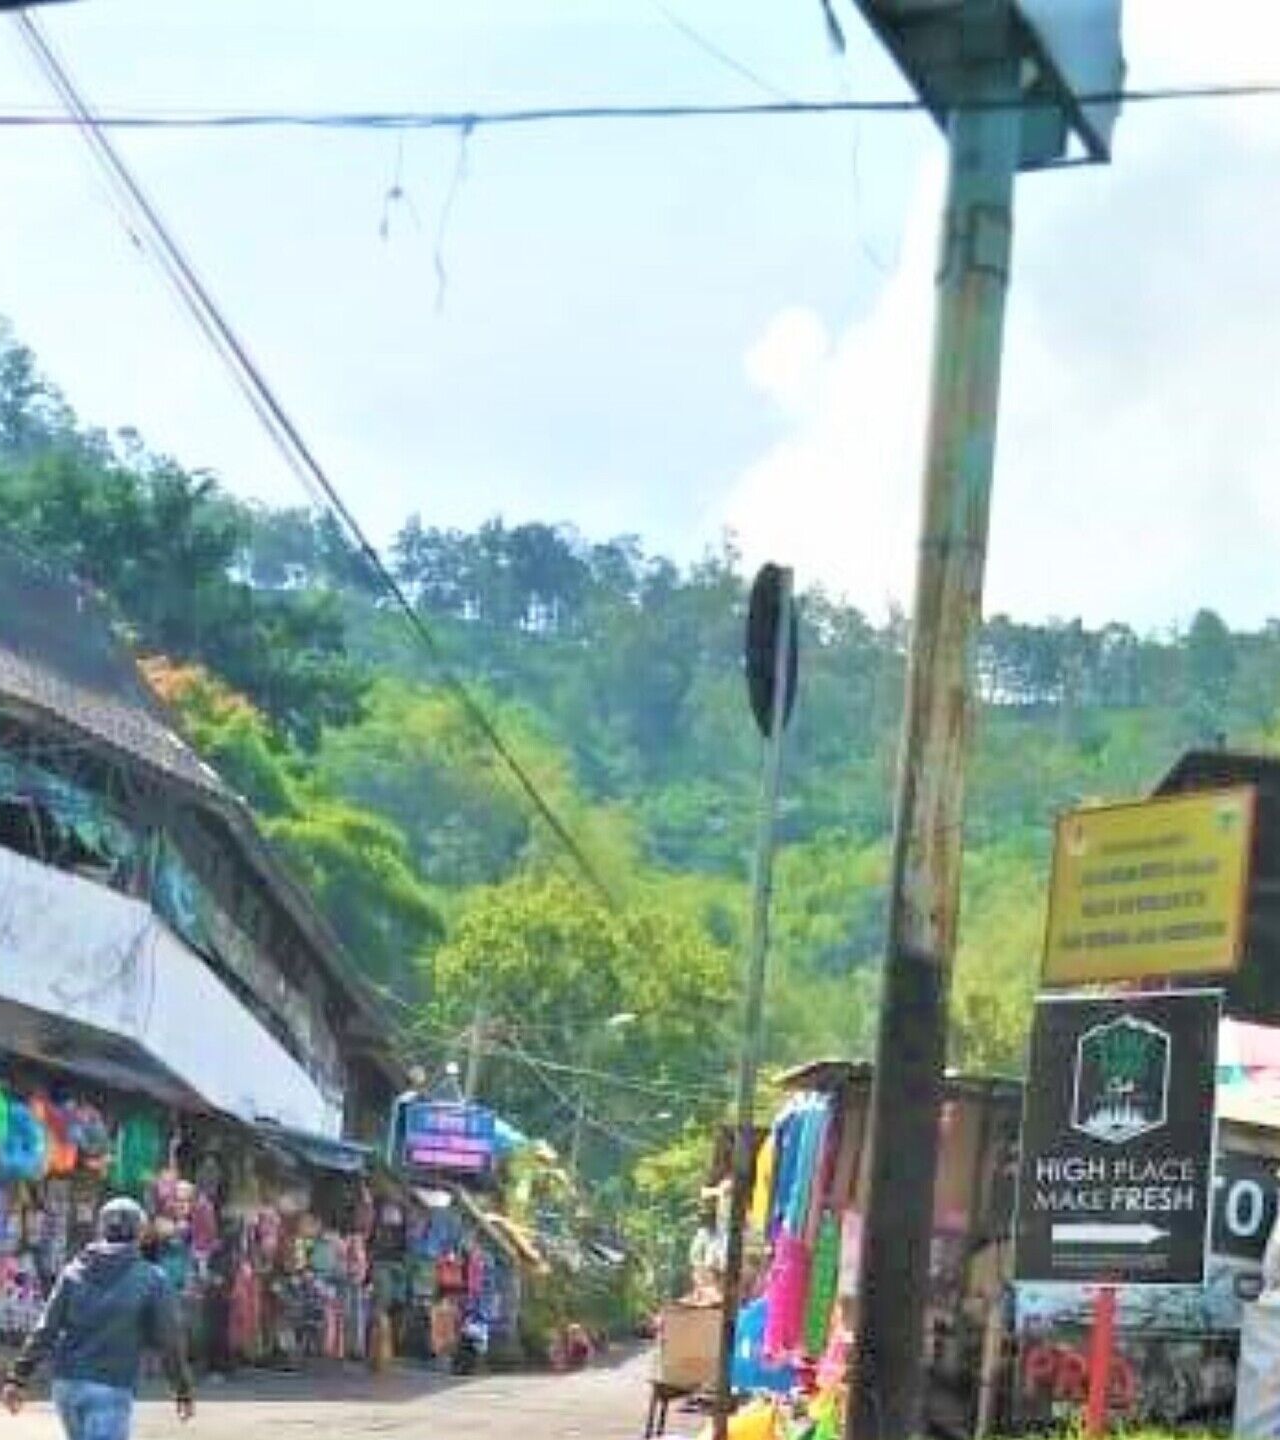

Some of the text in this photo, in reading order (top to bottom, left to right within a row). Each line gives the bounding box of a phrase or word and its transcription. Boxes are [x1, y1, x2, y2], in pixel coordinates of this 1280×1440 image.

[1036, 1156, 1195, 1182] HIGH PLACE
[1033, 1185, 1195, 1211] MAKE FRESH
